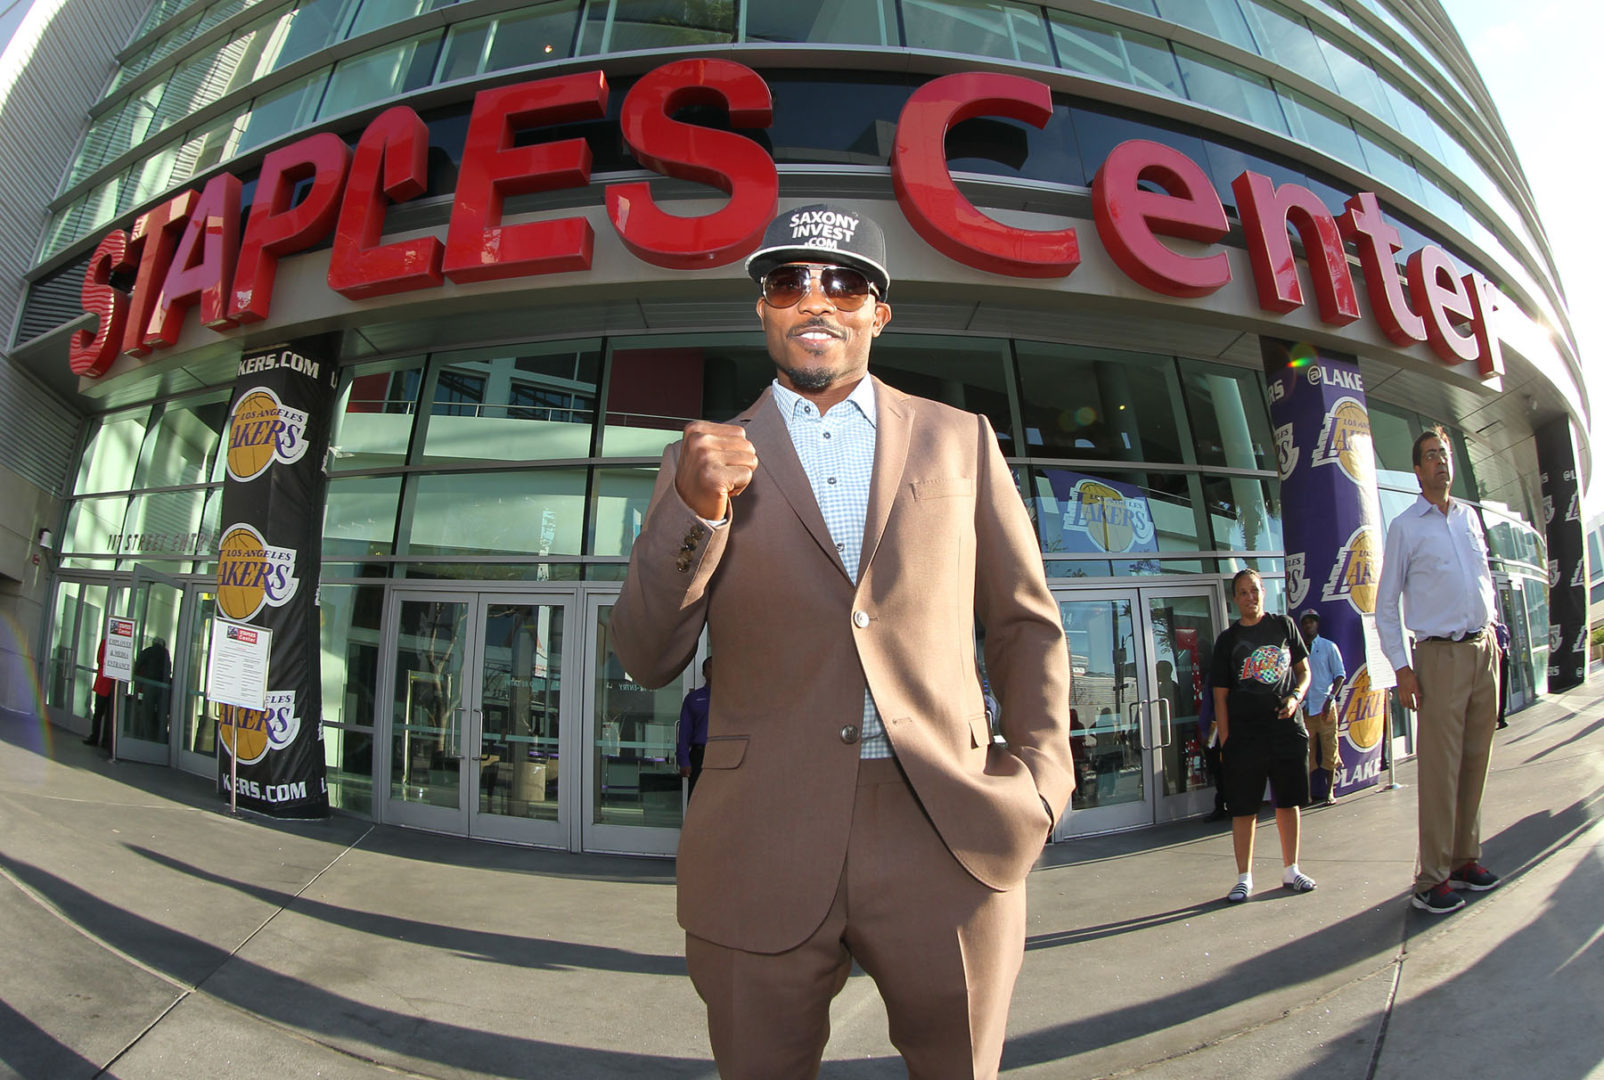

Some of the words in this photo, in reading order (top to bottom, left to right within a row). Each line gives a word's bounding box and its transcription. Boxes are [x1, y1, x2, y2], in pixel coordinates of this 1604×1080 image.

[69, 57, 779, 378] STAPLES
[890, 71, 1506, 380] Center
[789, 211, 859, 232] SAXONY
[792, 224, 855, 242] INVEST
[803, 237, 838, 249] .COM
[1307, 365, 1364, 392] @LAKE
[241, 410, 257, 421] LOS
[257, 408, 303, 423] ANGELES
[1068, 490, 1145, 539] LAKERS
[124, 534, 167, 551] STREET
[226, 549, 241, 558] LOS
[243, 549, 292, 561] ANGELES
